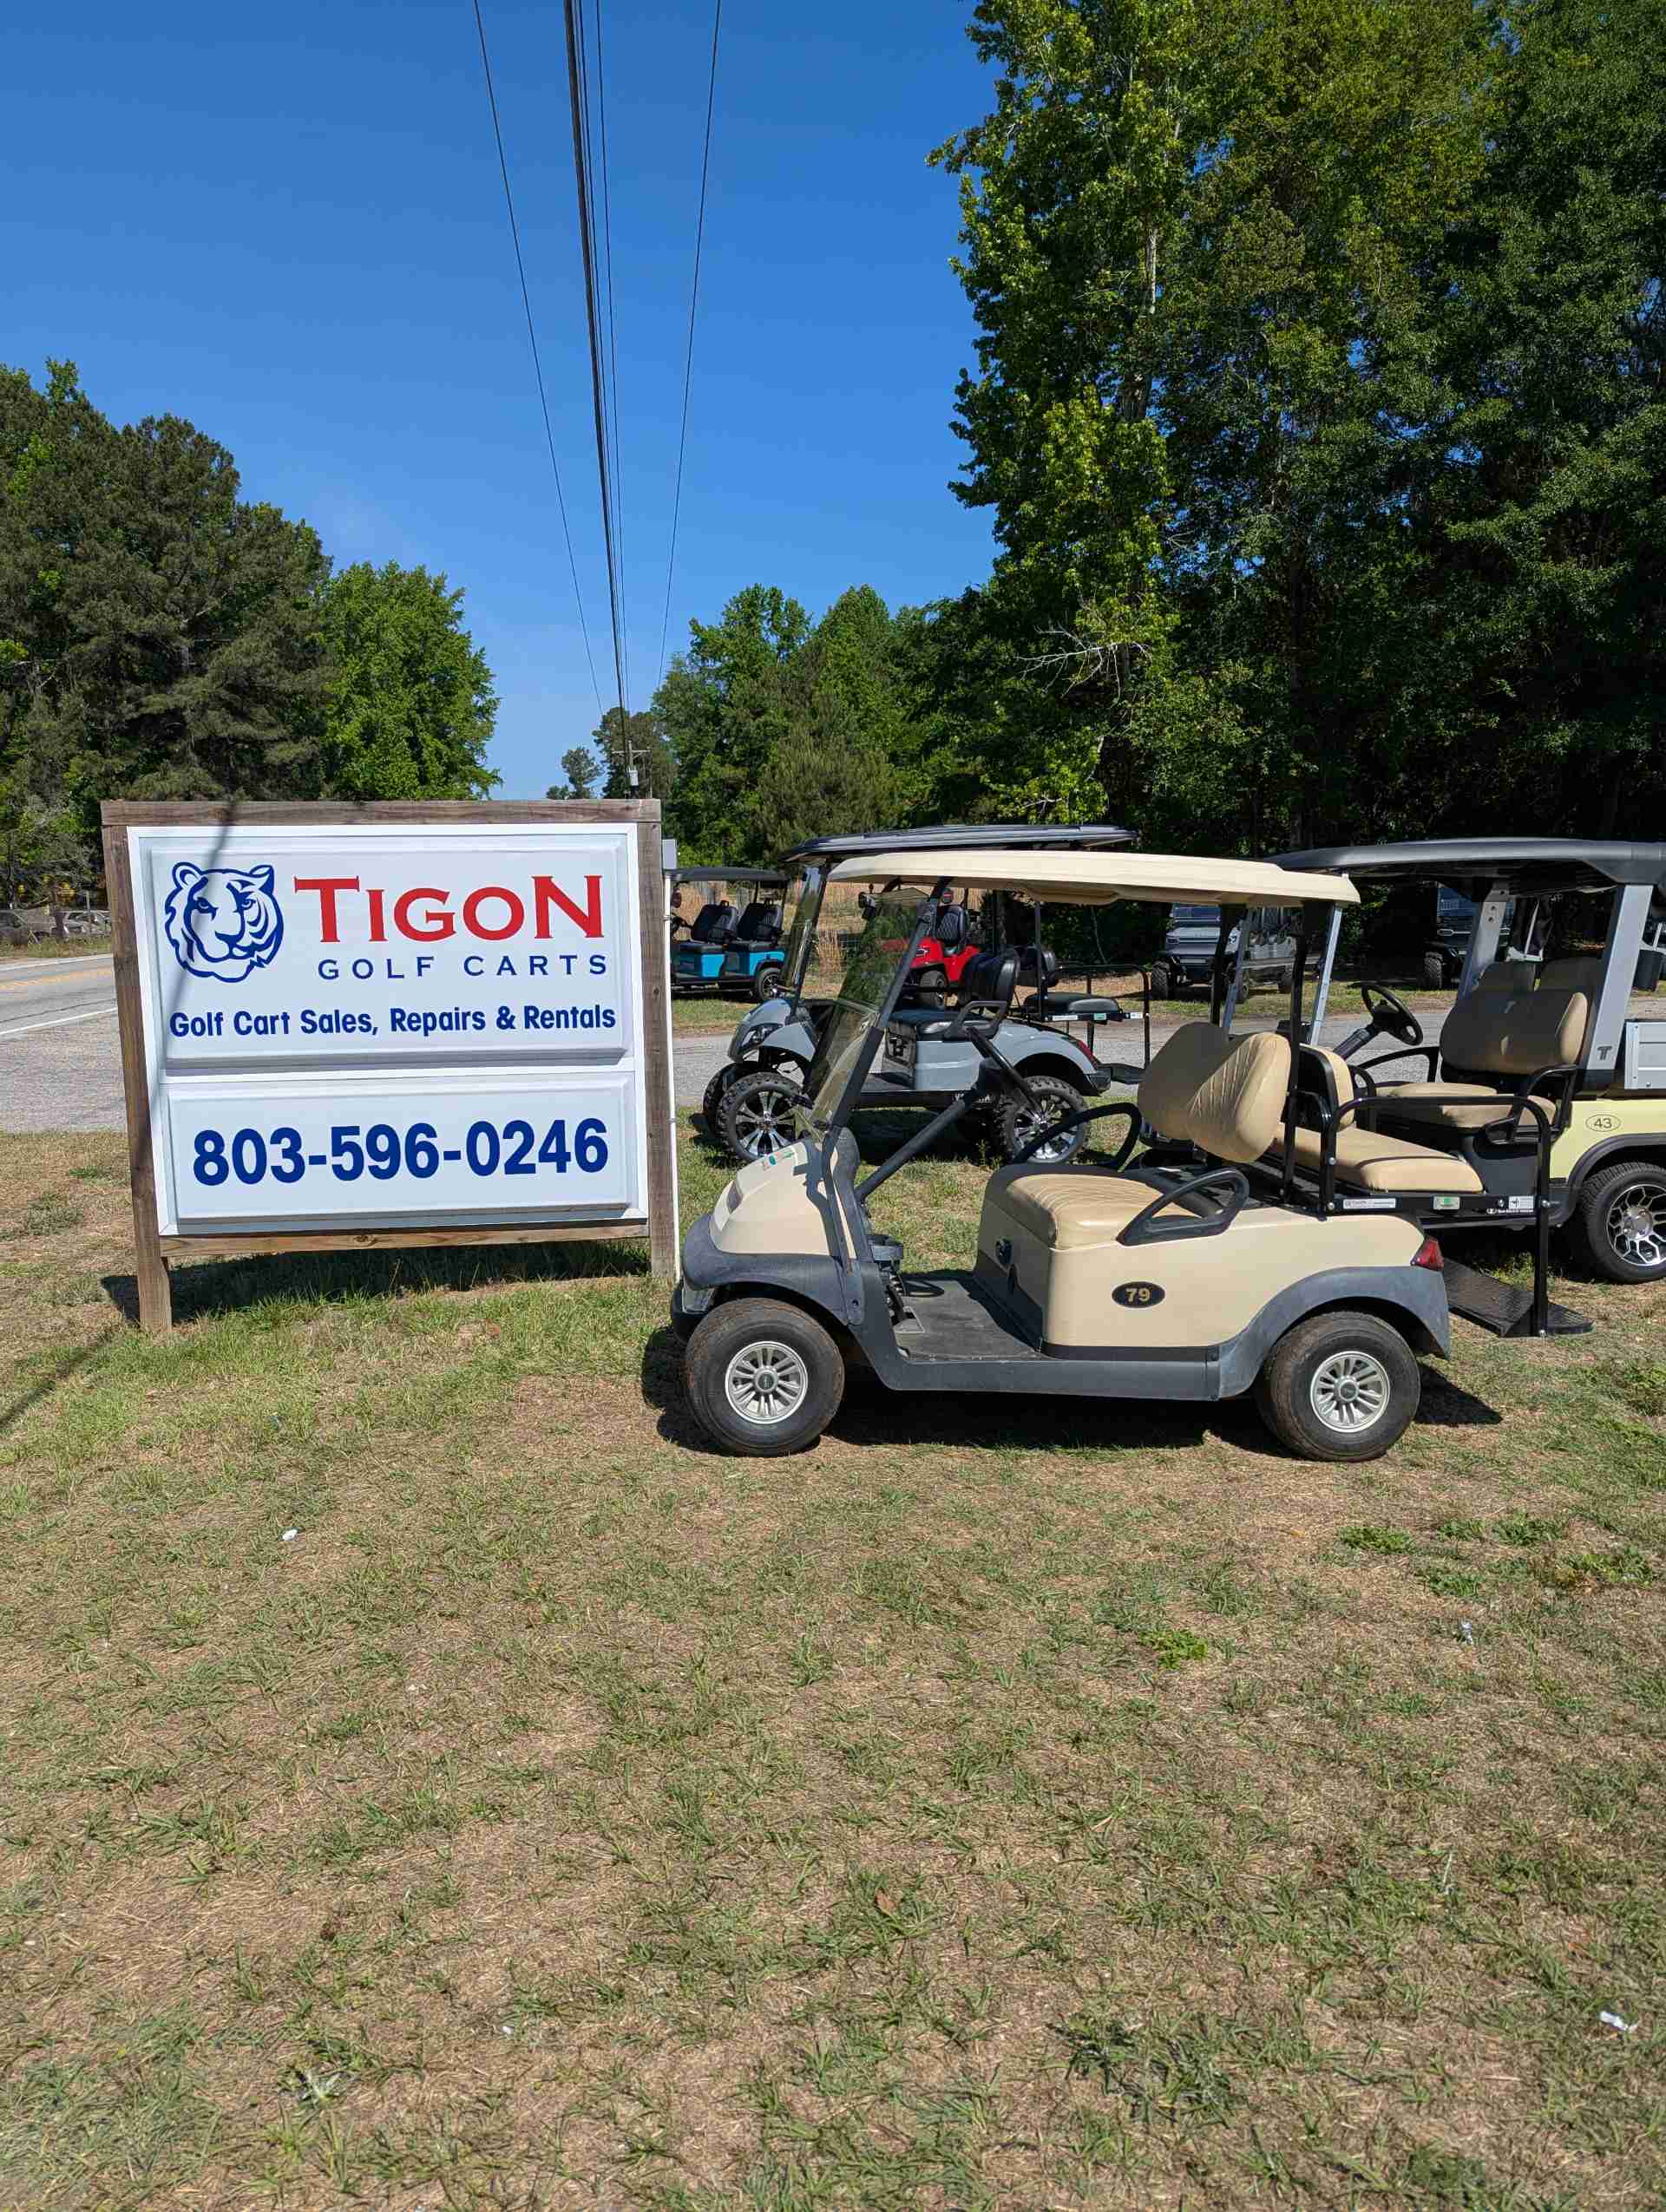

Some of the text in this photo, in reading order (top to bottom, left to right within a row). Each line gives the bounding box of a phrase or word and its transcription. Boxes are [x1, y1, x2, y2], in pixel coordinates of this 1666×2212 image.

[295, 874, 603, 944] TIGON
[318, 954, 607, 980] GOLF CARTS
[169, 1004, 616, 1037] Golf Cart Sales, Repairs & Rentals
[1594, 1117, 1612, 1129] 43
[193, 1117, 609, 1187] 803-596-0246
[1125, 1287, 1151, 1302] 79
